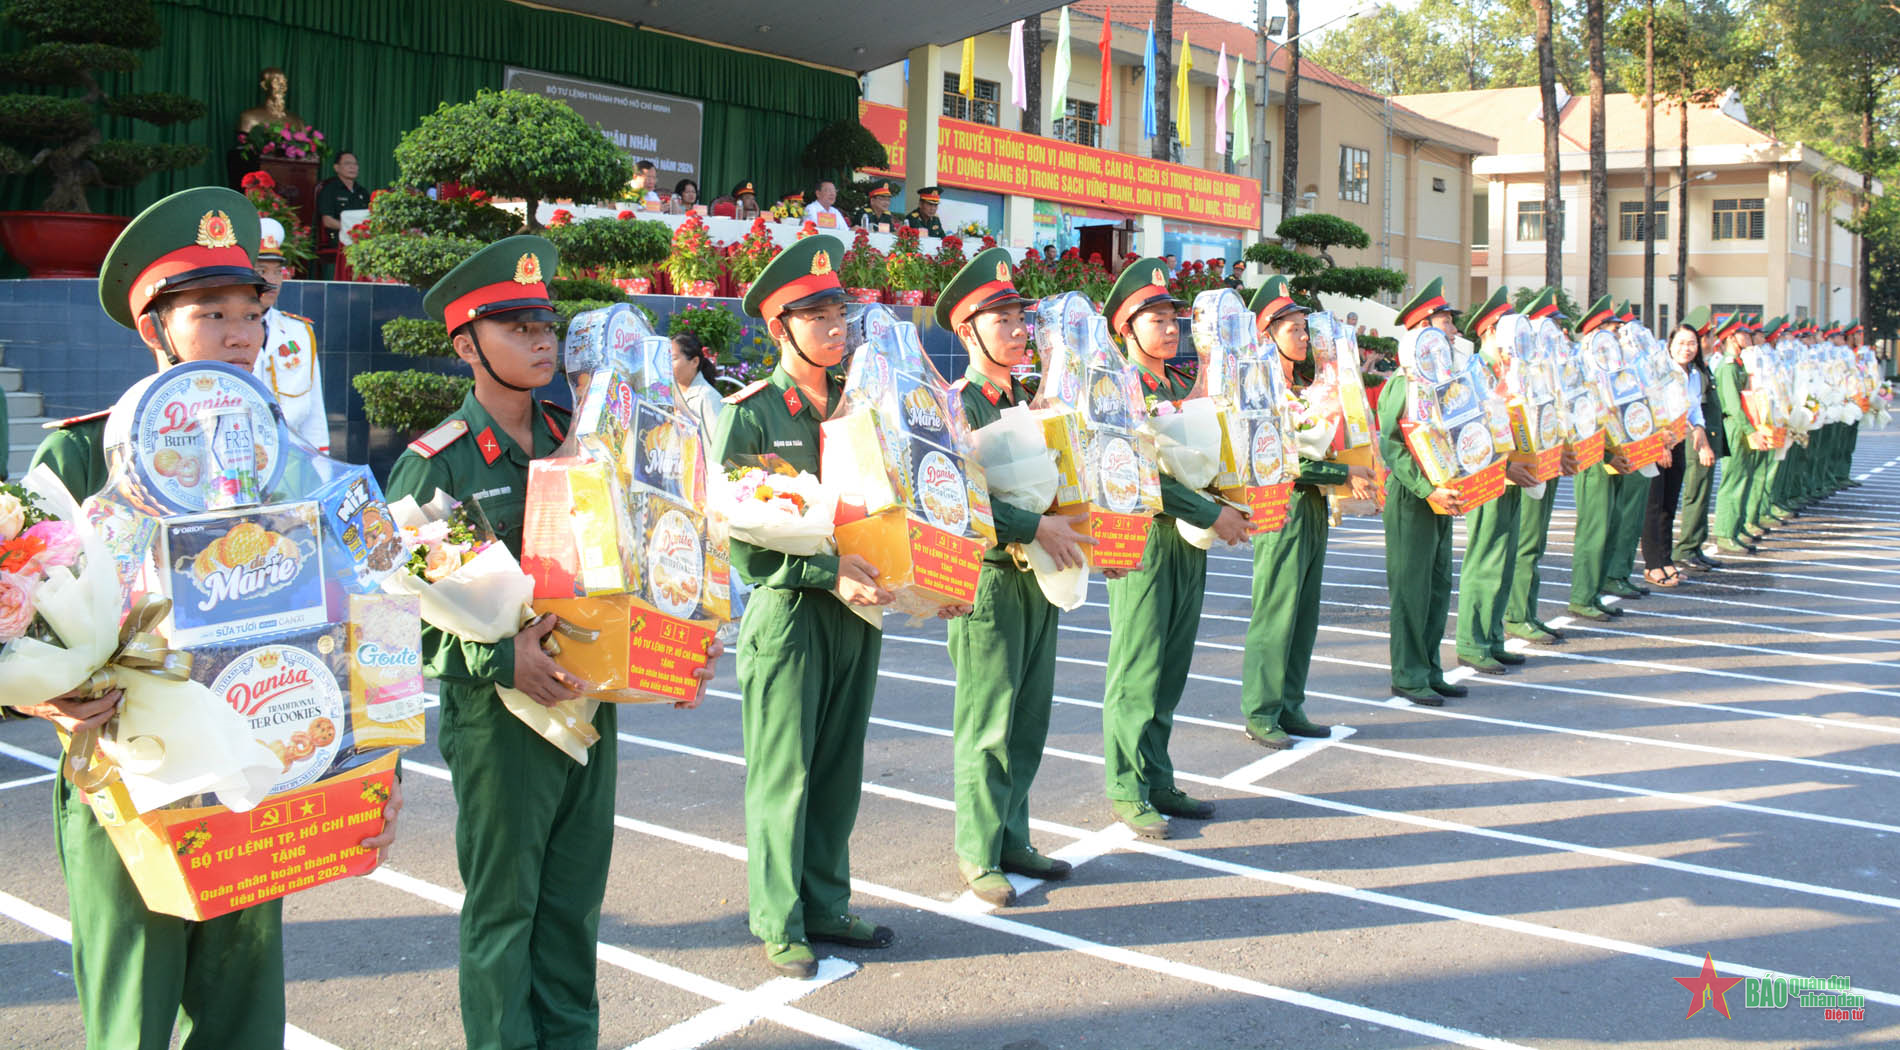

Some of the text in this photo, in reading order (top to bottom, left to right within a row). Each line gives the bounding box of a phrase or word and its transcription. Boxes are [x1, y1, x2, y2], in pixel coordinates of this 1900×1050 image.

[629, 134, 657, 152] NHÂN
[1058, 152, 1077, 171] ANH
[1030, 171, 1059, 192] TRONG
[1062, 177, 1084, 198] SẠCH
[198, 558, 296, 612] Marie
[226, 666, 313, 715] Danisa
[268, 697, 316, 713] TRADITIONAL
[272, 706, 322, 725] COOKIES
[191, 807, 382, 870] BỘ TƯ LỆNH TP. HỒ CHÍ MINH
[271, 844, 307, 865] TẶNG
[200, 884, 233, 902] Quân
[237, 872, 268, 892] nhân
[271, 862, 302, 880] hoàn
[304, 852, 337, 870] thành
[230, 863, 348, 908] tiêu biểu năm 2024
